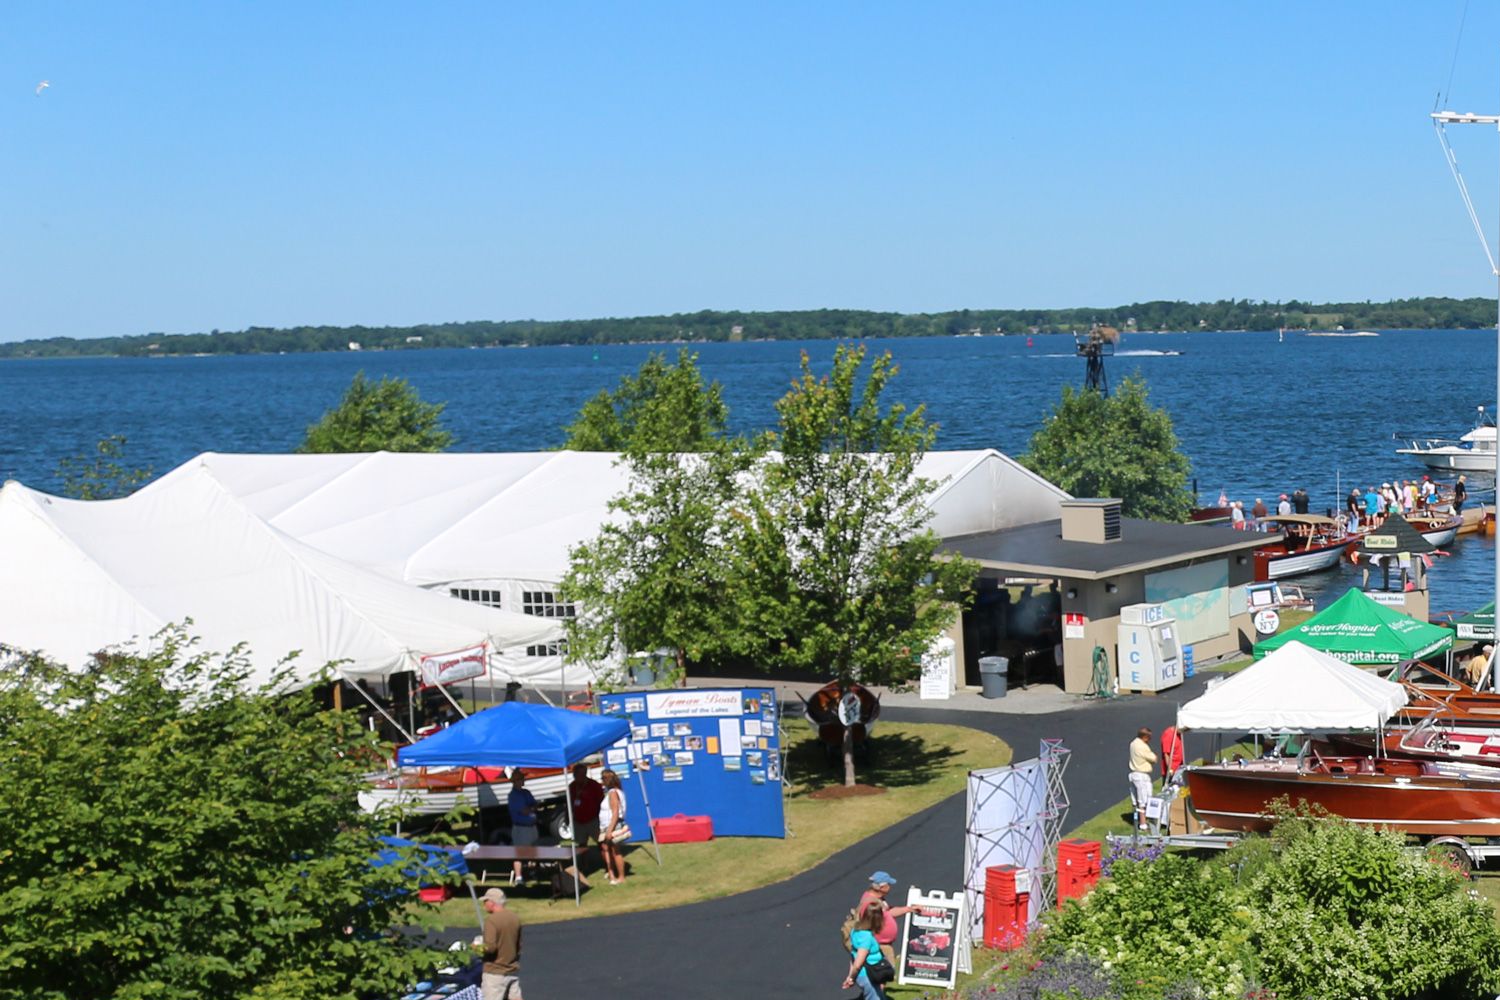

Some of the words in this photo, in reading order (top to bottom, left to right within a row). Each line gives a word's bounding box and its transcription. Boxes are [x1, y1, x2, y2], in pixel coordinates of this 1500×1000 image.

[1143, 606, 1163, 623] ICE
[1259, 620, 1276, 630] NY
[1129, 631, 1141, 684] ICE
[1161, 662, 1177, 680] ICE
[703, 693, 737, 704] Boats
[665, 708, 690, 716] Legend
